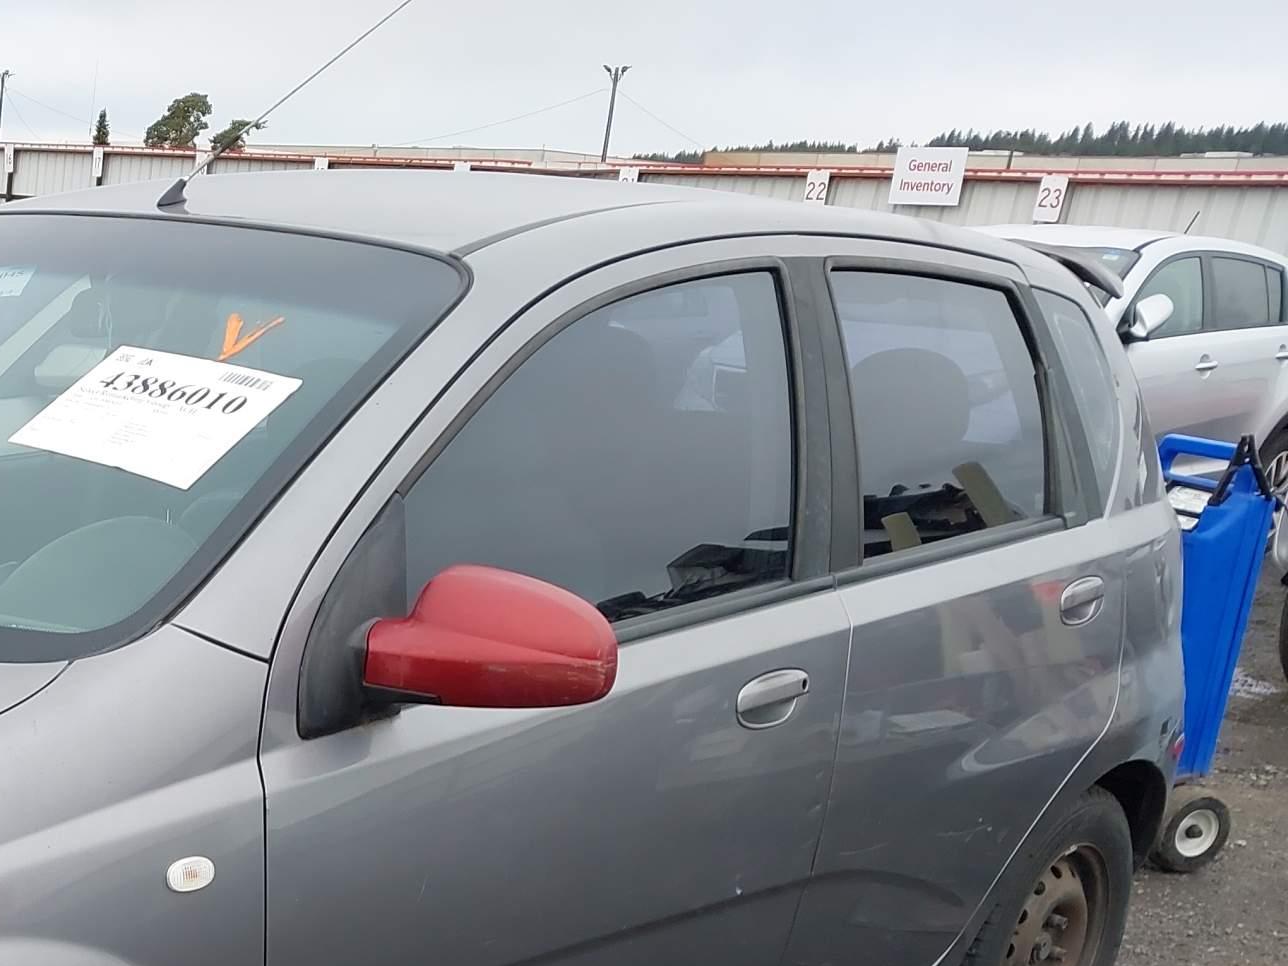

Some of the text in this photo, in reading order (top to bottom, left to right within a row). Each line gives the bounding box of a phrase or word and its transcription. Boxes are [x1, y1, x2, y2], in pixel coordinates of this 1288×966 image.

[908, 158, 952, 174] General
[805, 182, 827, 201] 22
[899, 178, 953, 195] Inventory
[1038, 187, 1062, 208] 23
[99, 371, 248, 415] 43886010
